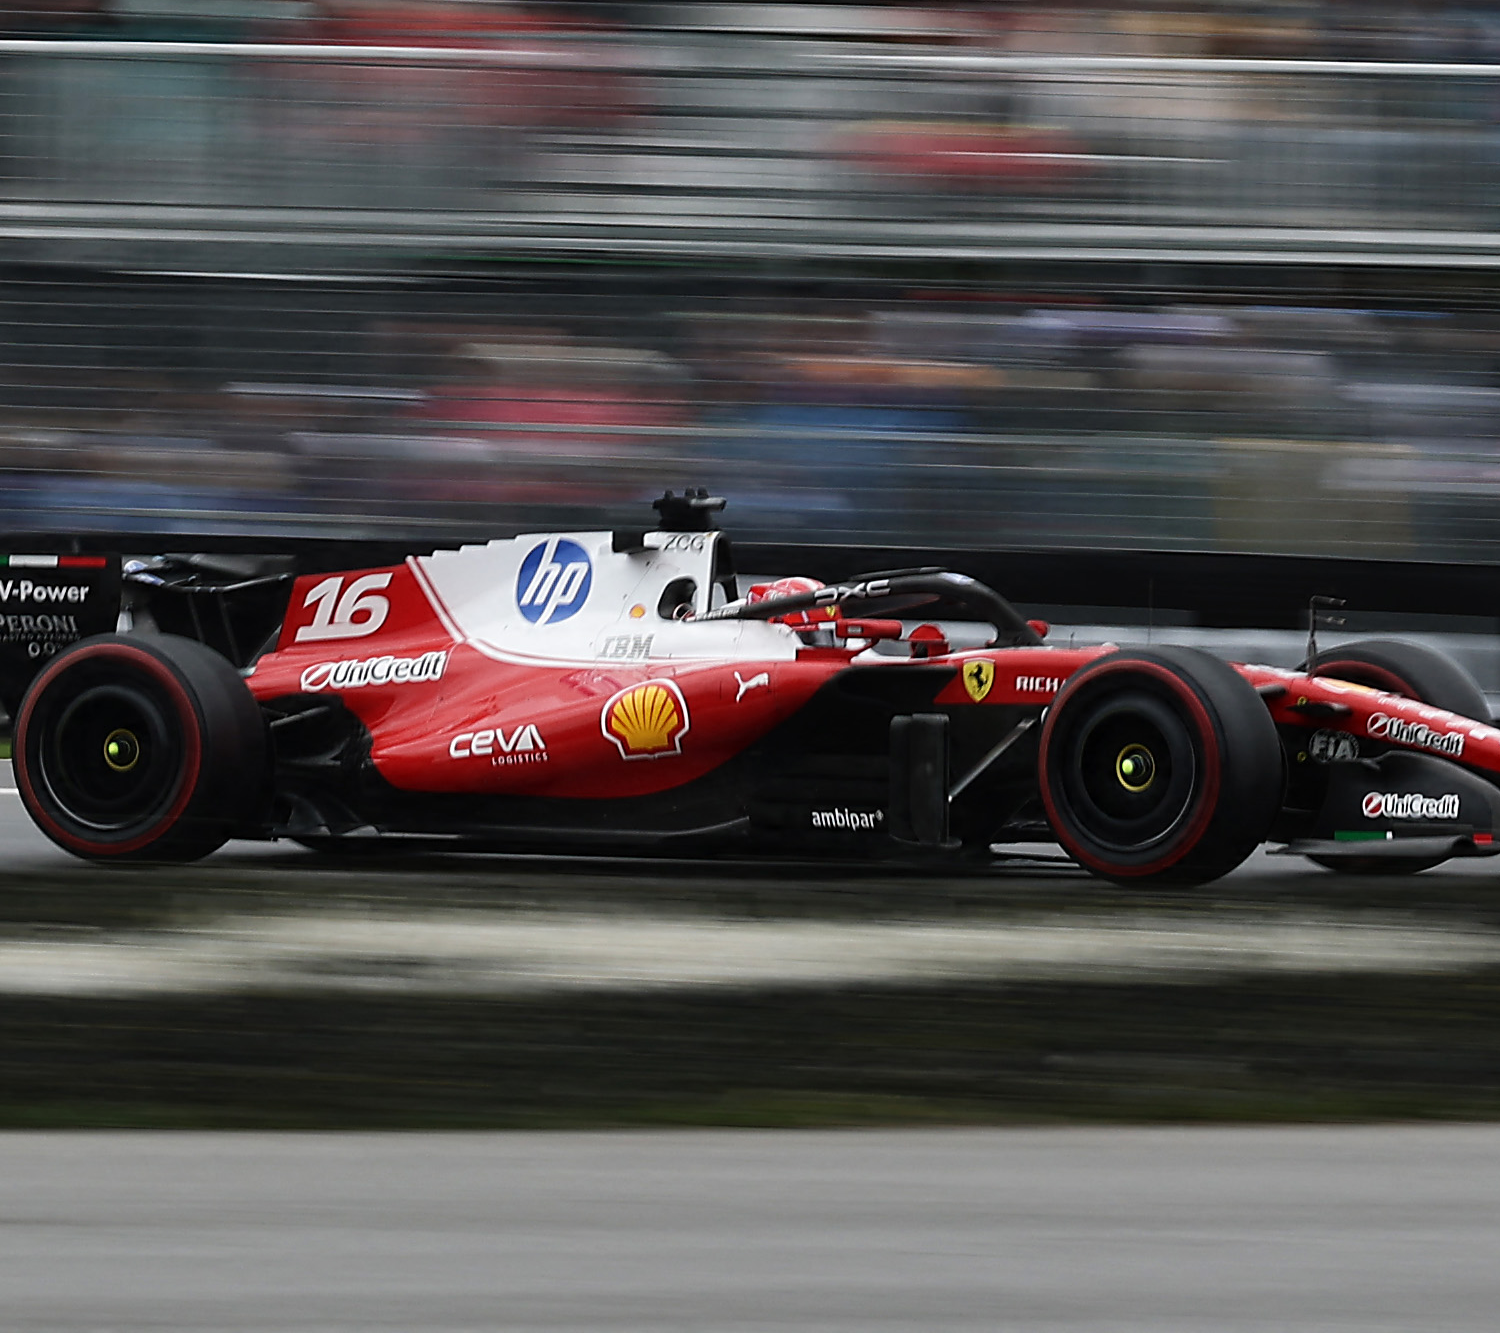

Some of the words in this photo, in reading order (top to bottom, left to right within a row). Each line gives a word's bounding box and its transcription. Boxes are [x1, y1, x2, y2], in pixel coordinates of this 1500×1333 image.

[520, 536, 590, 626] hp
[815, 579, 891, 606] DXC
[294, 572, 393, 643] 16
[597, 634, 655, 659] IBM
[331, 651, 446, 687] UniCredit
[1311, 734, 1354, 760] FIA
[1387, 717, 1465, 757] UniCredit
[491, 752, 548, 767] LOGISTICS
[1382, 793, 1459, 818] UniCredit
